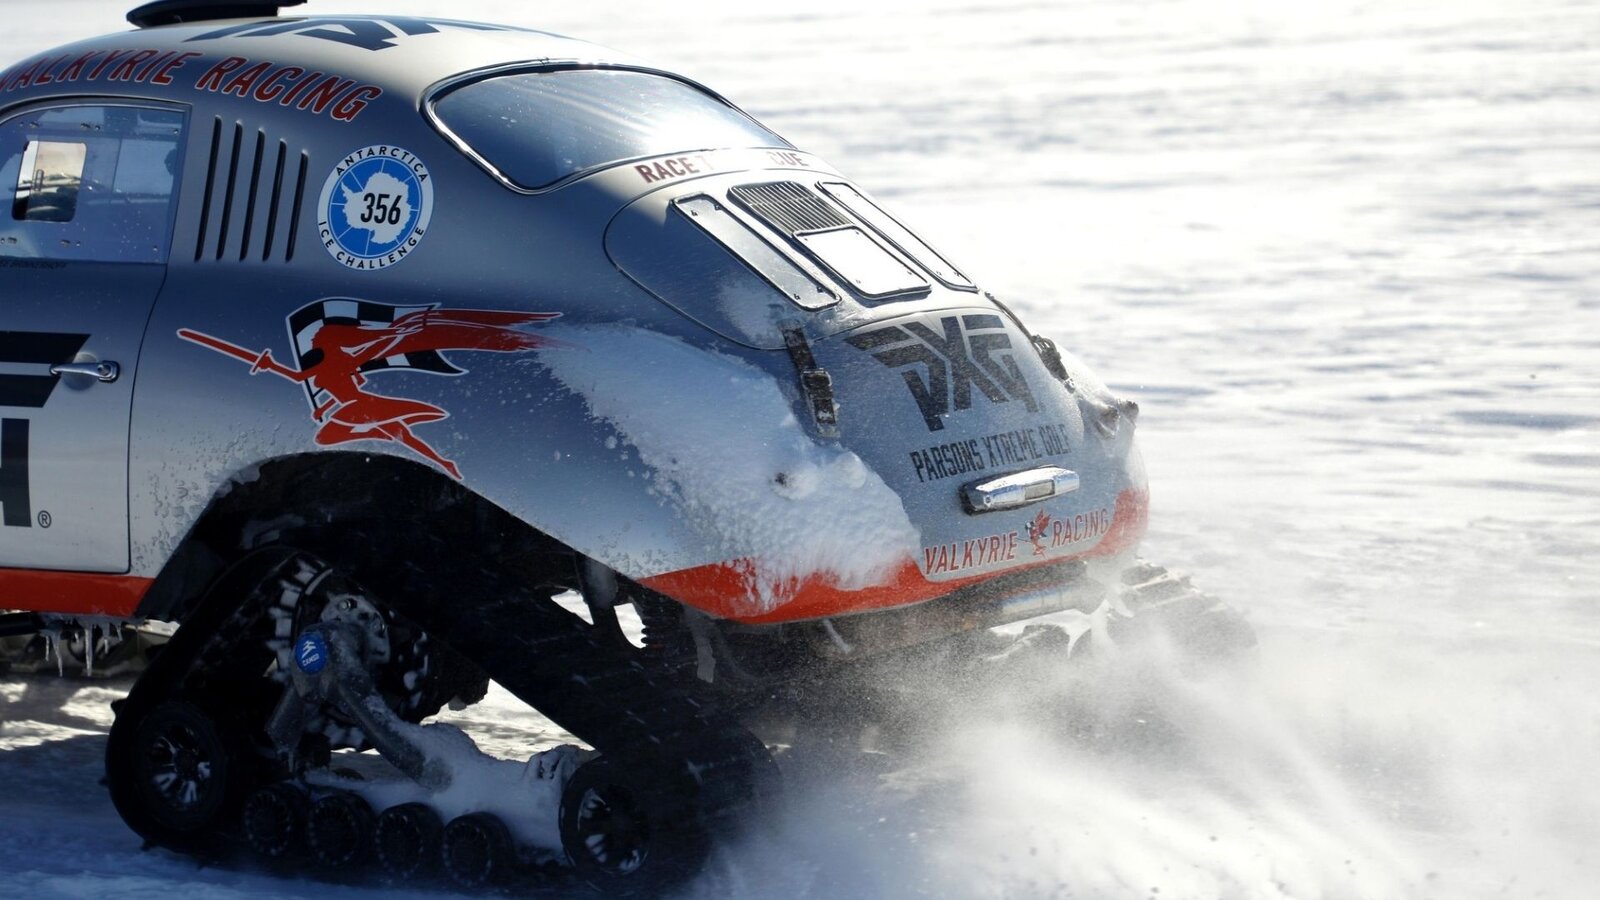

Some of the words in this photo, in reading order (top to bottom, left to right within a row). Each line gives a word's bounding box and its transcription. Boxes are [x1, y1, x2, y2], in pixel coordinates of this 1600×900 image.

[195, 56, 384, 122] RACING
[336, 146, 428, 182] ANTARCTICA
[634, 156, 701, 184] RACE
[360, 192, 402, 225] 356
[318, 221, 335, 248] ICE
[336, 227, 424, 269] CHALLENGE
[843, 314, 1040, 432] PXG
[909, 438, 985, 482] PARSONS
[981, 428, 1043, 468] XTREME
[1038, 423, 1072, 456] GOLF
[924, 532, 1018, 575] VALKYRIE
[1051, 508, 1110, 548] RACING
